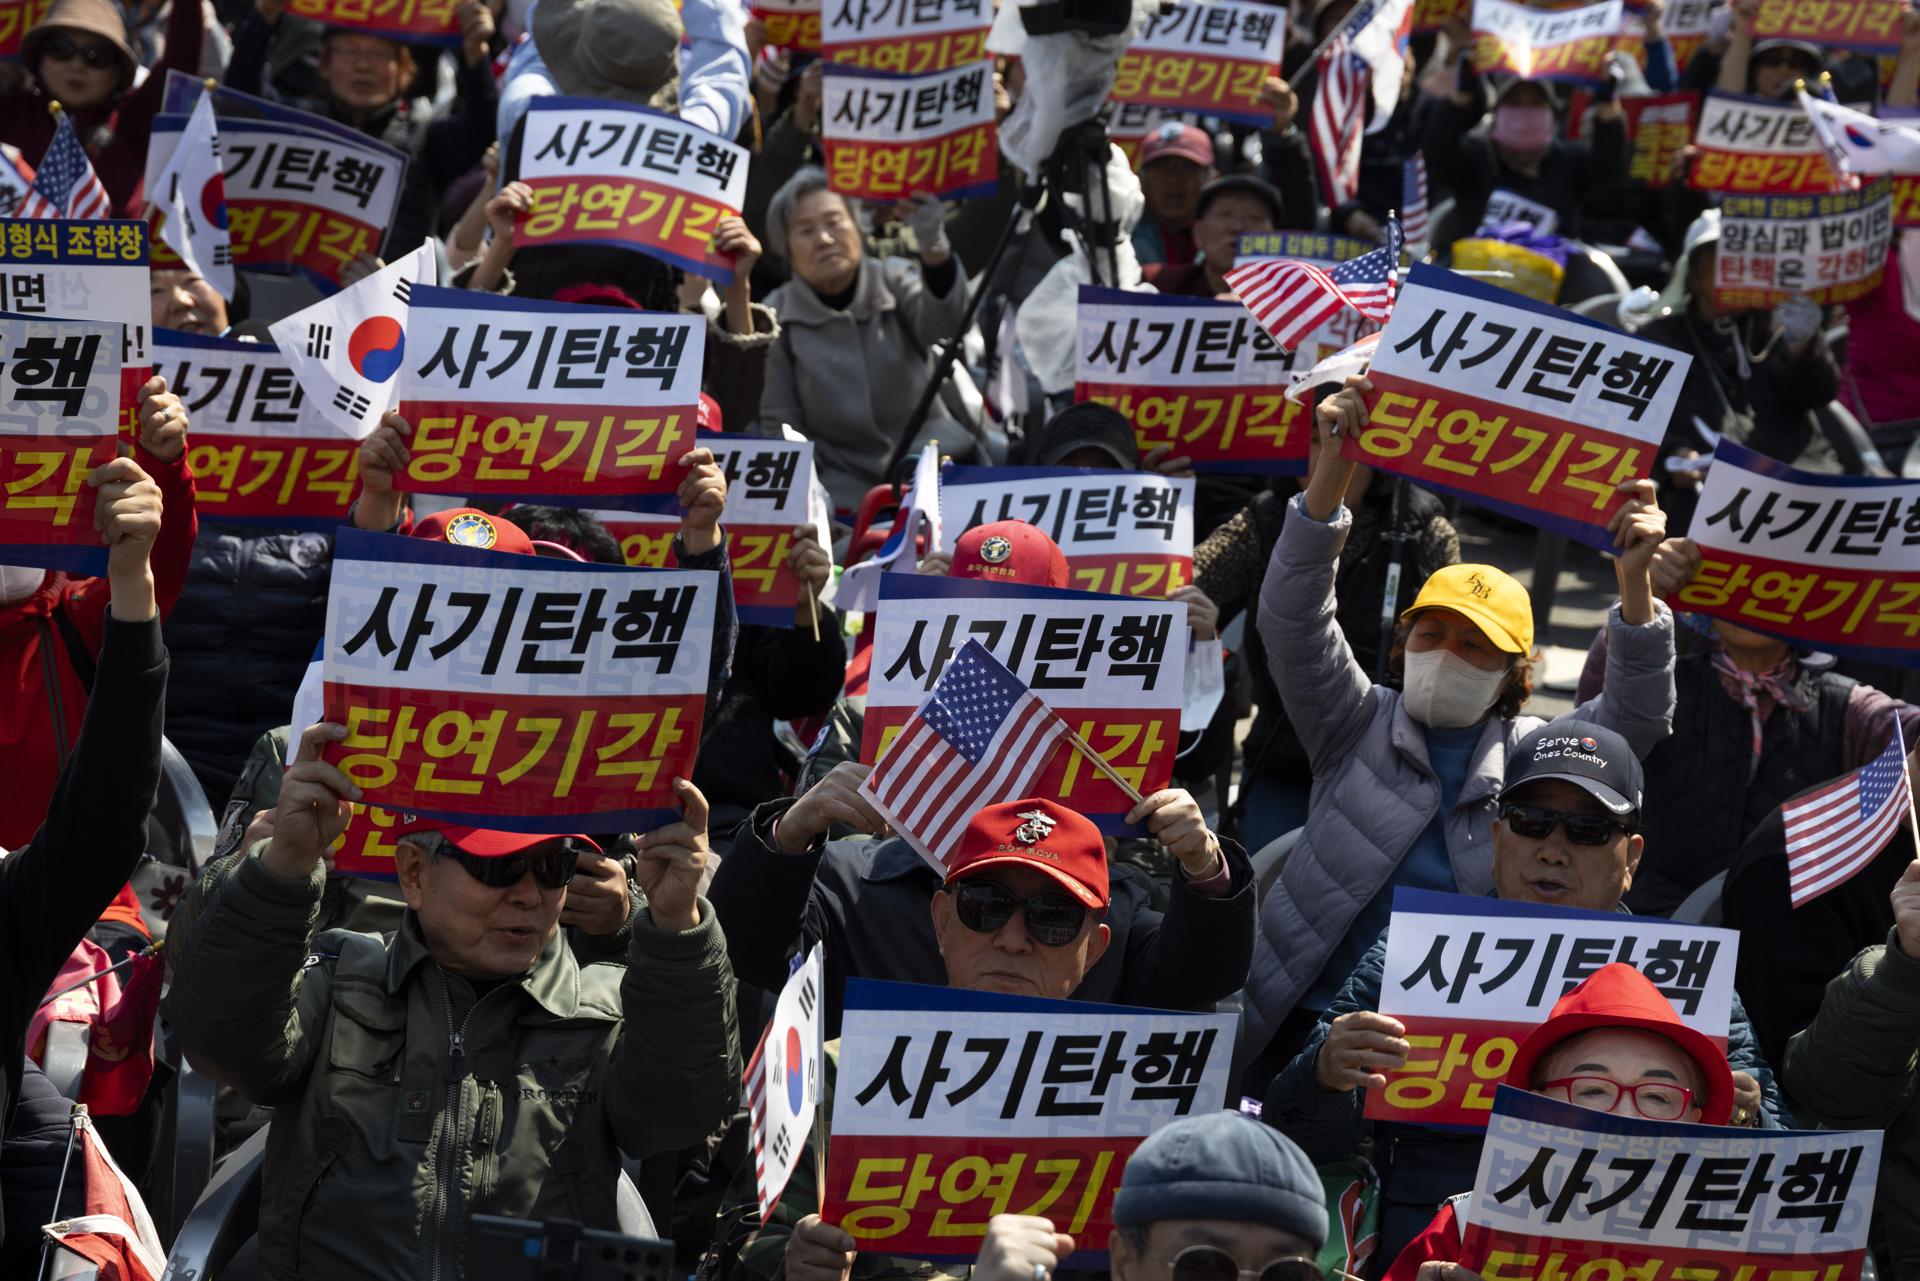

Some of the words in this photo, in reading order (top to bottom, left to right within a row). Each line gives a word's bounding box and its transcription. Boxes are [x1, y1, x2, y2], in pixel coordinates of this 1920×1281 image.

[832, 69, 986, 132] 사기탄핵
[1111, 54, 1272, 105] 당연기각
[534, 119, 738, 191] 사기탄핵
[832, 132, 988, 192] 당연기각
[1708, 109, 1816, 145] 사기탄
[223, 141, 386, 209] 기탄핵
[66, 224, 144, 261] 조한창
[523, 182, 728, 254] 당연기각
[0, 333, 102, 418] 핵
[417, 323, 691, 391] 사기탄핵
[1394, 308, 1674, 423] 사기탄핵
[185, 447, 360, 505] 연기각
[406, 413, 681, 484] 당연기각
[1358, 390, 1642, 511] 당연기각
[342, 582, 699, 675] 사기탄핵
[883, 613, 1174, 692] 사기탄핵
[335, 704, 684, 798] 당연기각
[1533, 748, 1561, 762] One's
[1562, 746, 1609, 769] Country
[1535, 736, 1580, 751] Serve
[854, 1028, 1219, 1120] 사기탄핵
[840, 1150, 1141, 1241] 당연기
[1492, 1145, 1866, 1234] 사기탄핵
